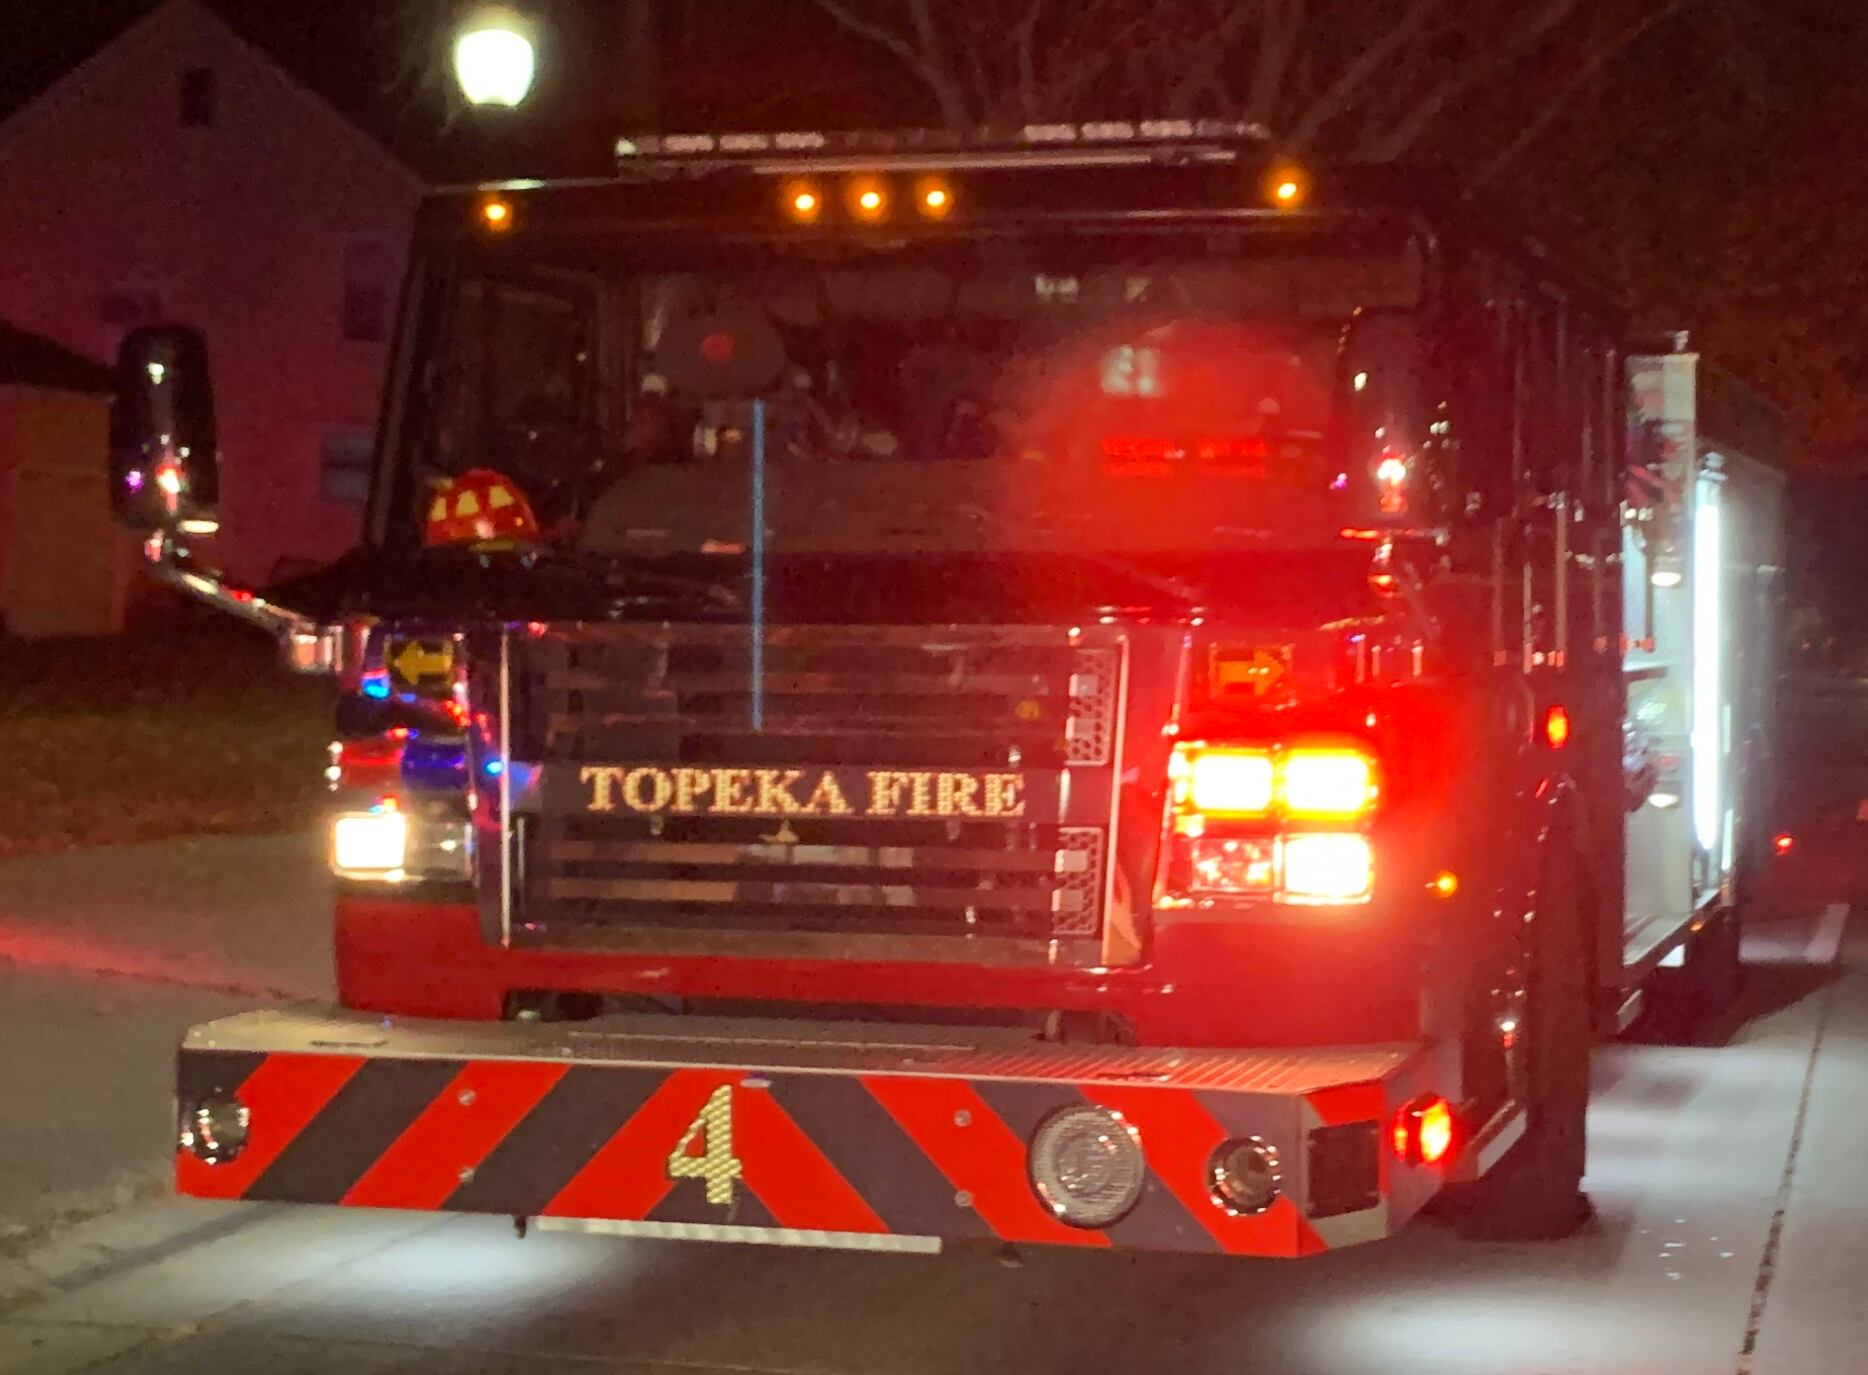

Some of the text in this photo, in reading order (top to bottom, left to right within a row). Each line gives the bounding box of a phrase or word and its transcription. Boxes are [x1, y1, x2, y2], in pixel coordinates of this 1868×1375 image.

[580, 766, 1026, 817] TOPEKA FIRE
[668, 1084, 742, 1204] 4
